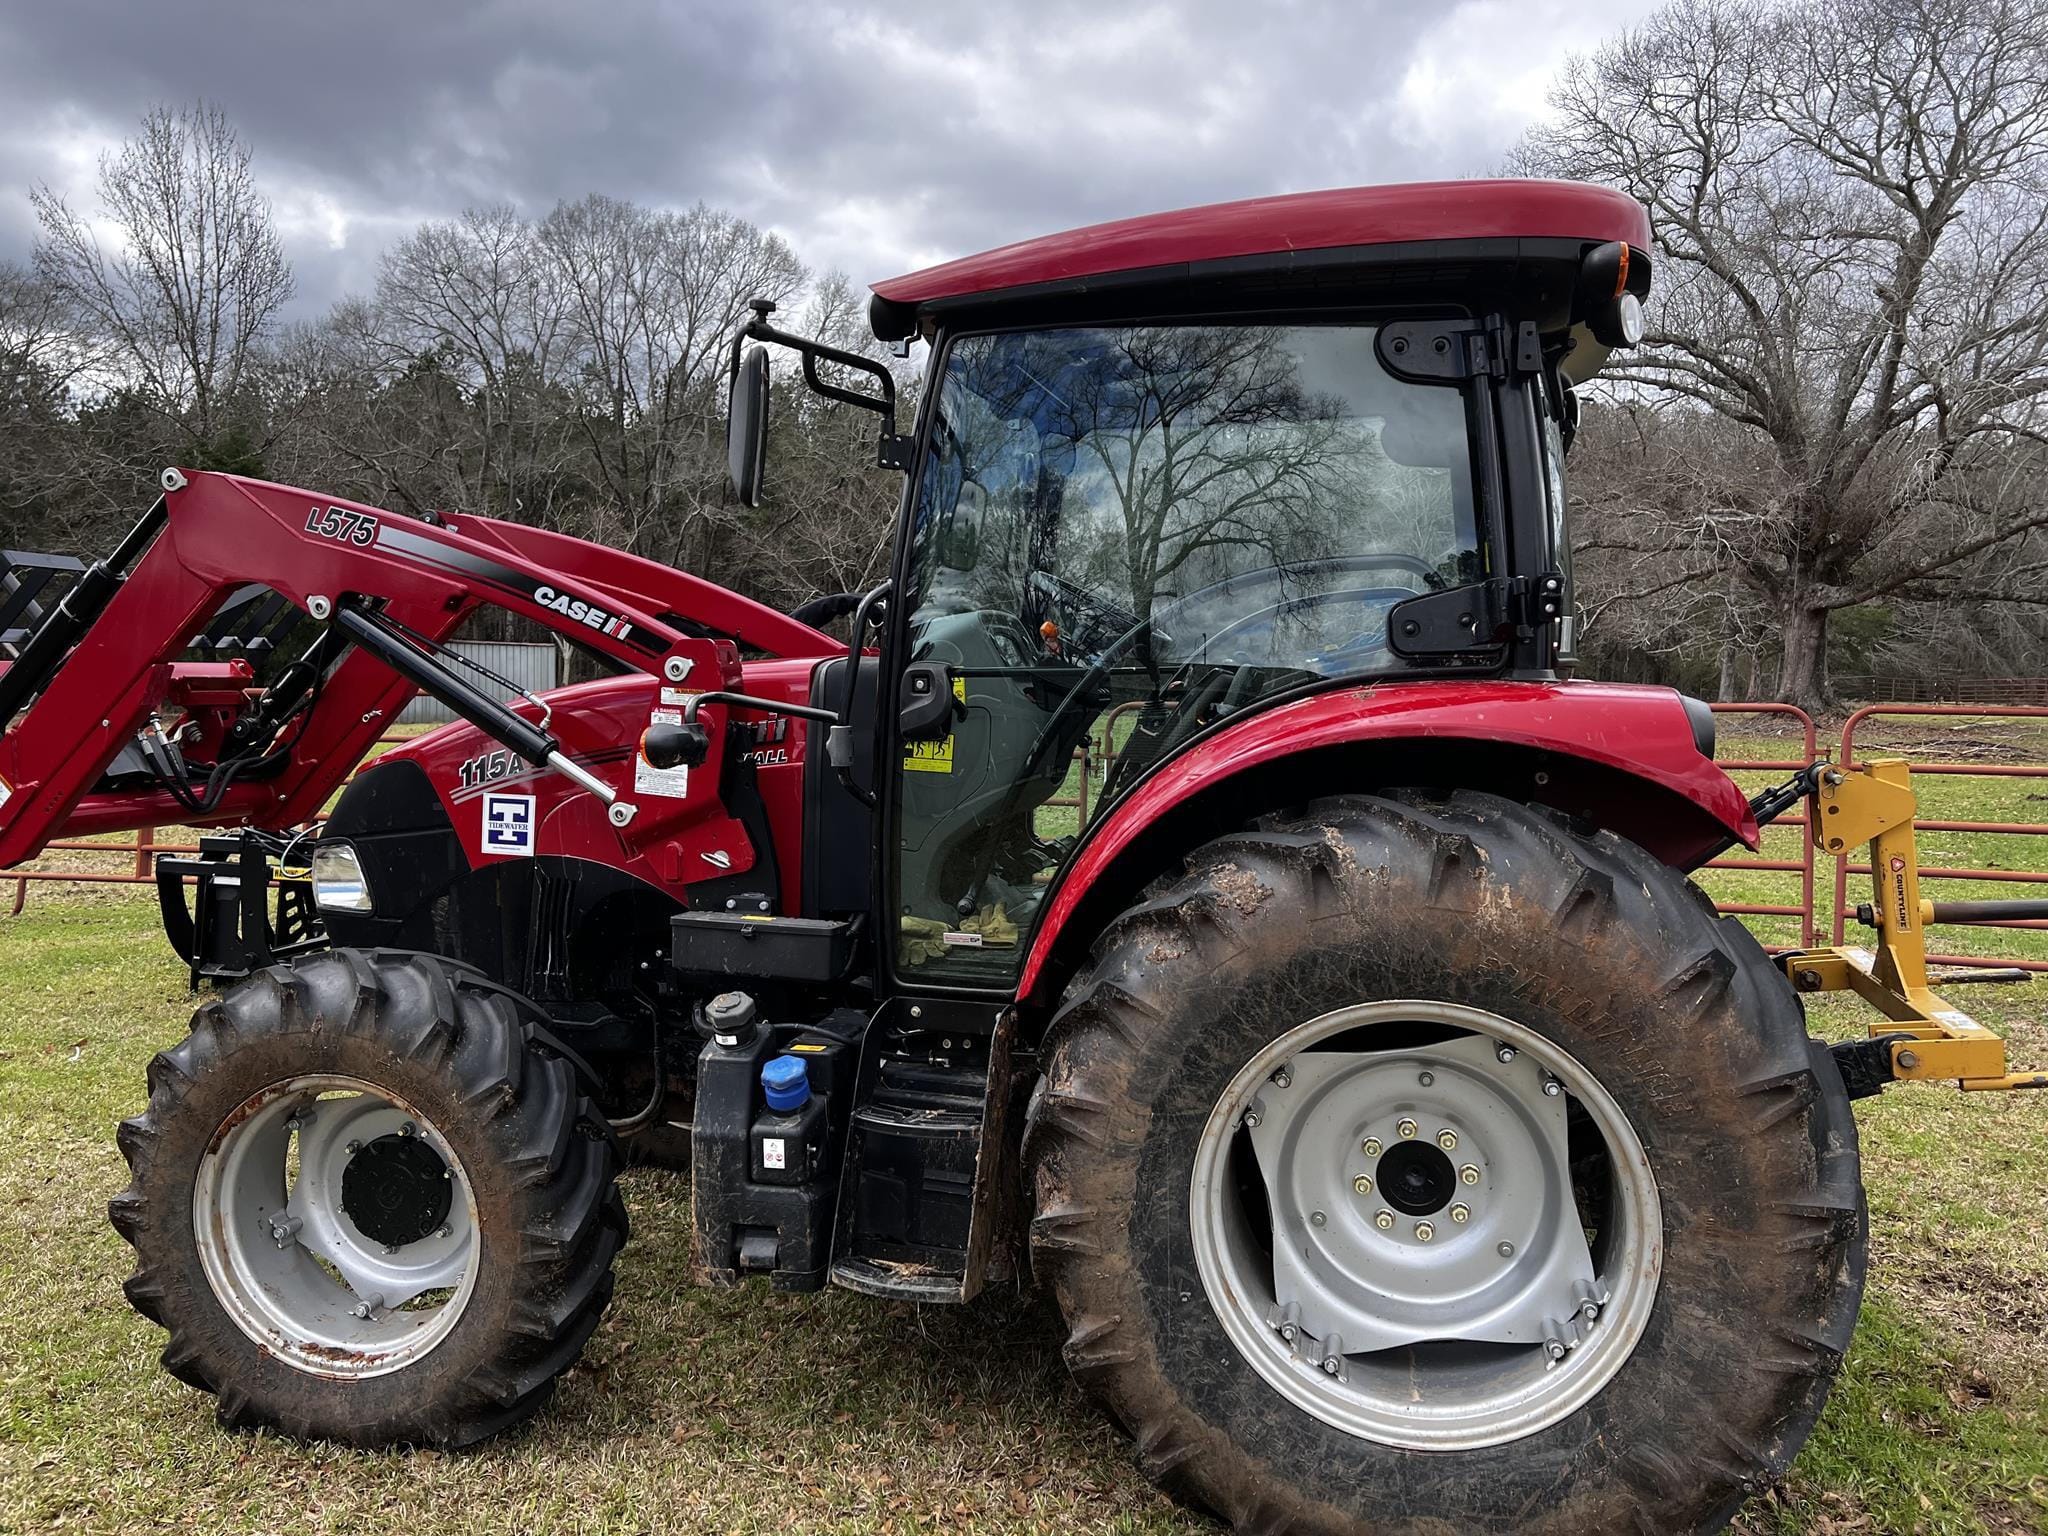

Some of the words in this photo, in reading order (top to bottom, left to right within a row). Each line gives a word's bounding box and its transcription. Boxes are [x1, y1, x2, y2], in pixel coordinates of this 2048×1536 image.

[304, 505, 378, 547] L575
[534, 586, 608, 630] CASE
[488, 821, 529, 831] TIDEWATER
[1896, 873, 1907, 928] COUNTYLINE
